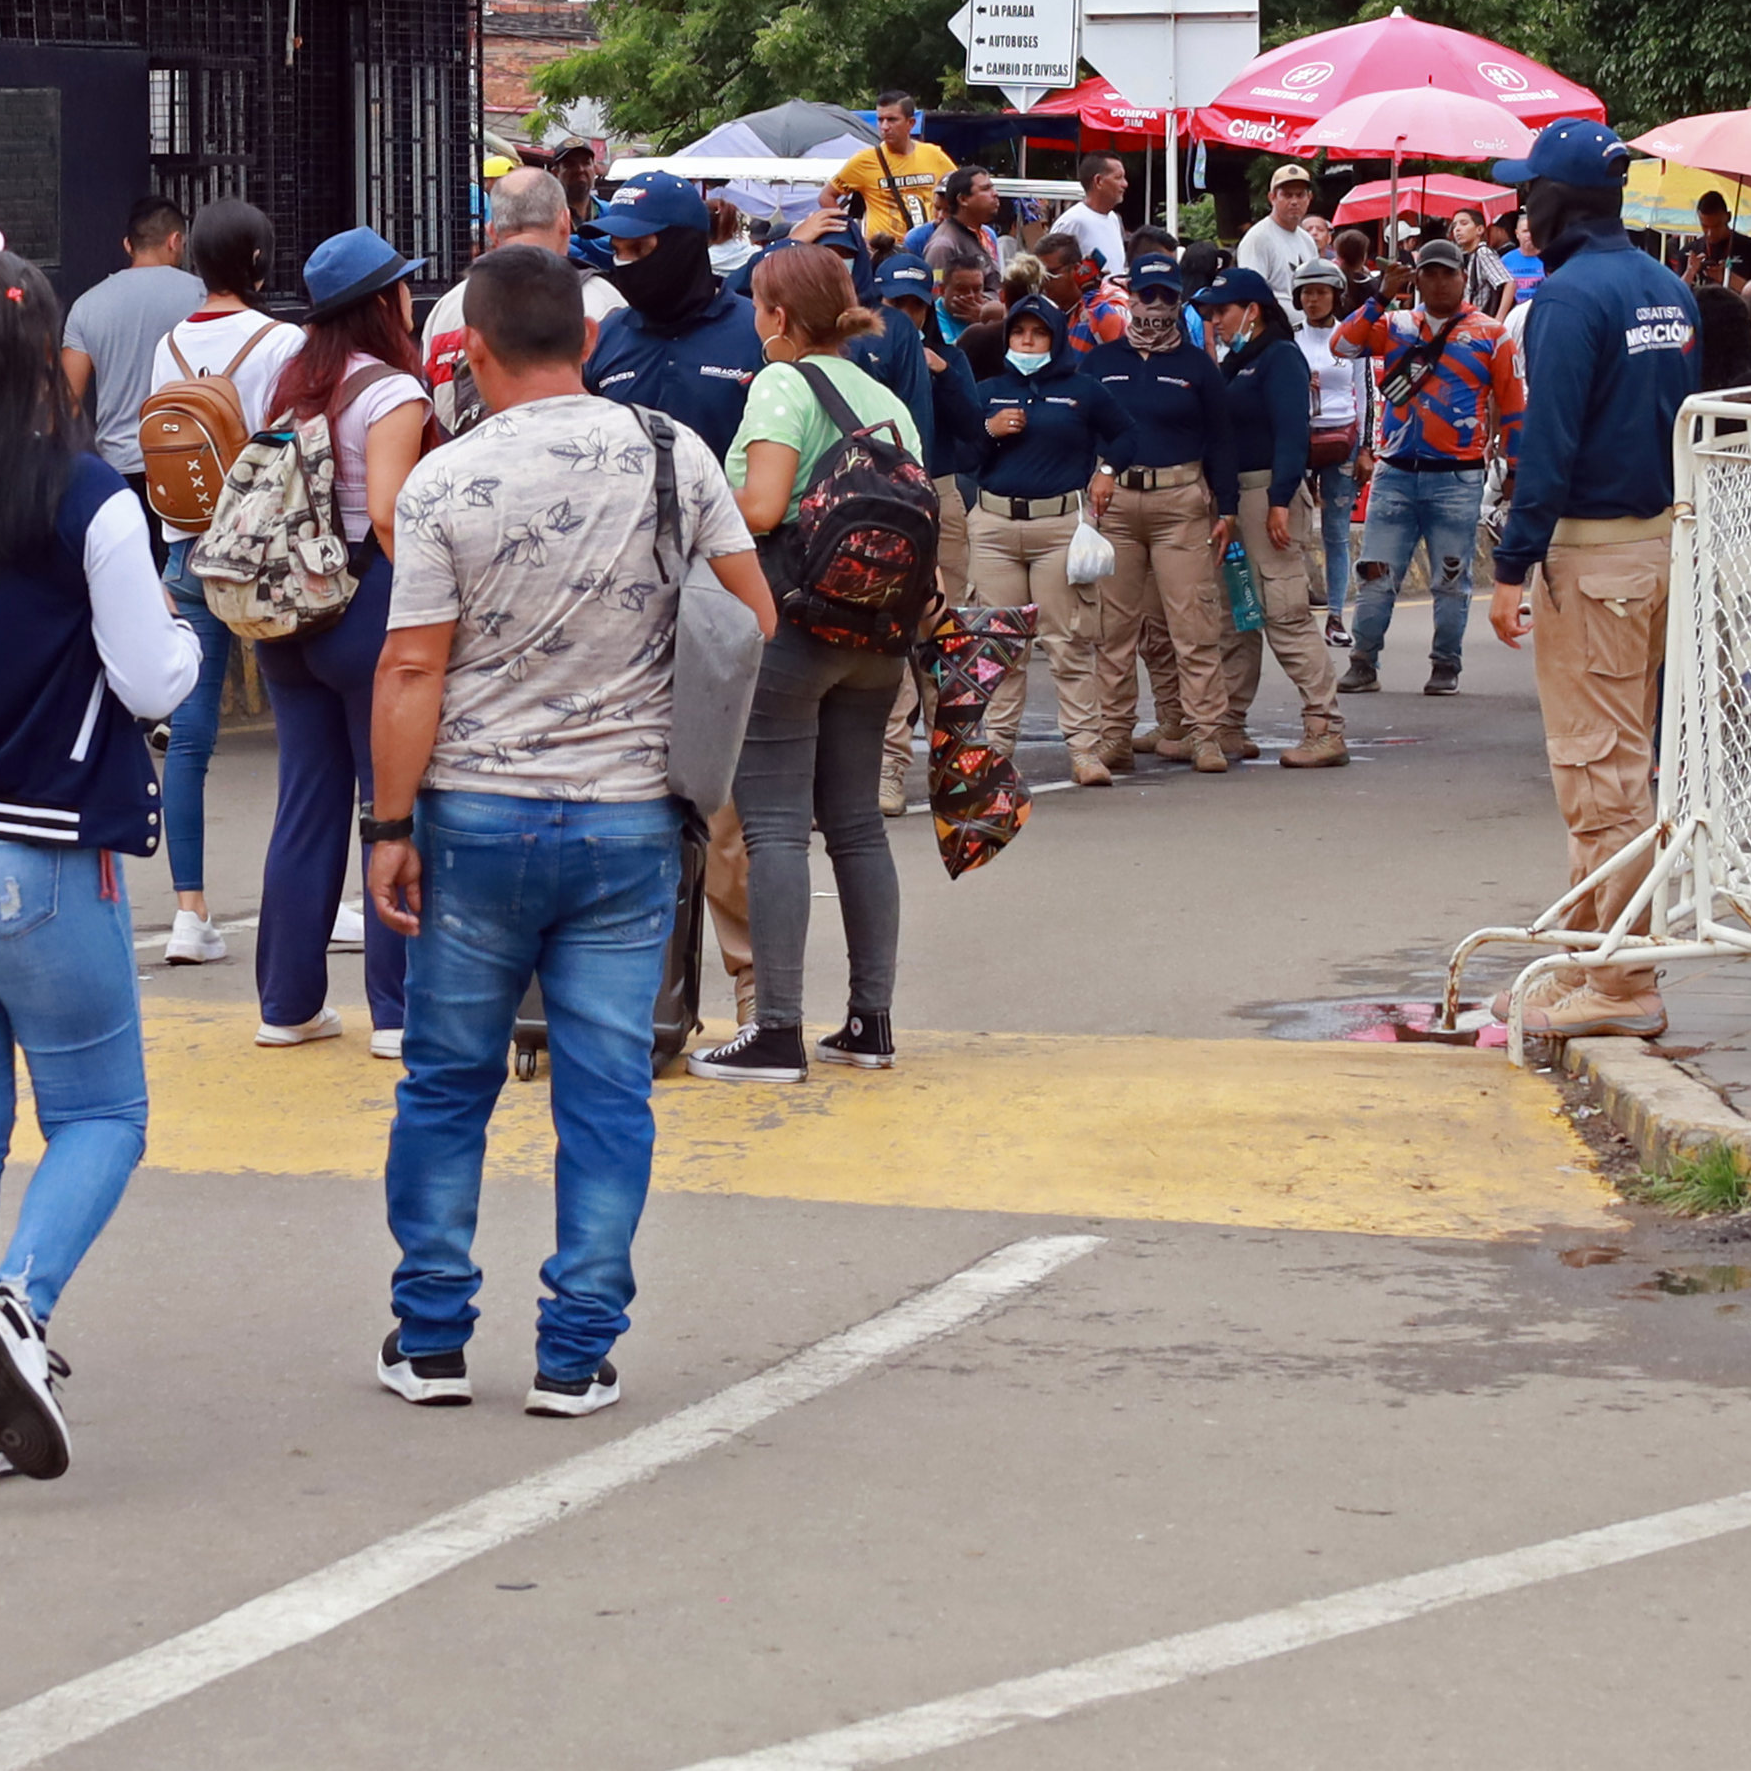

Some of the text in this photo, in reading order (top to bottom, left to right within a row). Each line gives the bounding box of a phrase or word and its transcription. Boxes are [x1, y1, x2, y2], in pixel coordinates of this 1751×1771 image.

[990, 5, 1035, 18] LA PARADA
[989, 35, 1039, 48] AUTOBUSES
[986, 62, 1069, 77] CAMBIO DE DIVISAS
[1110, 109, 1158, 120] COMPRA
[1228, 117, 1282, 143] Claro
